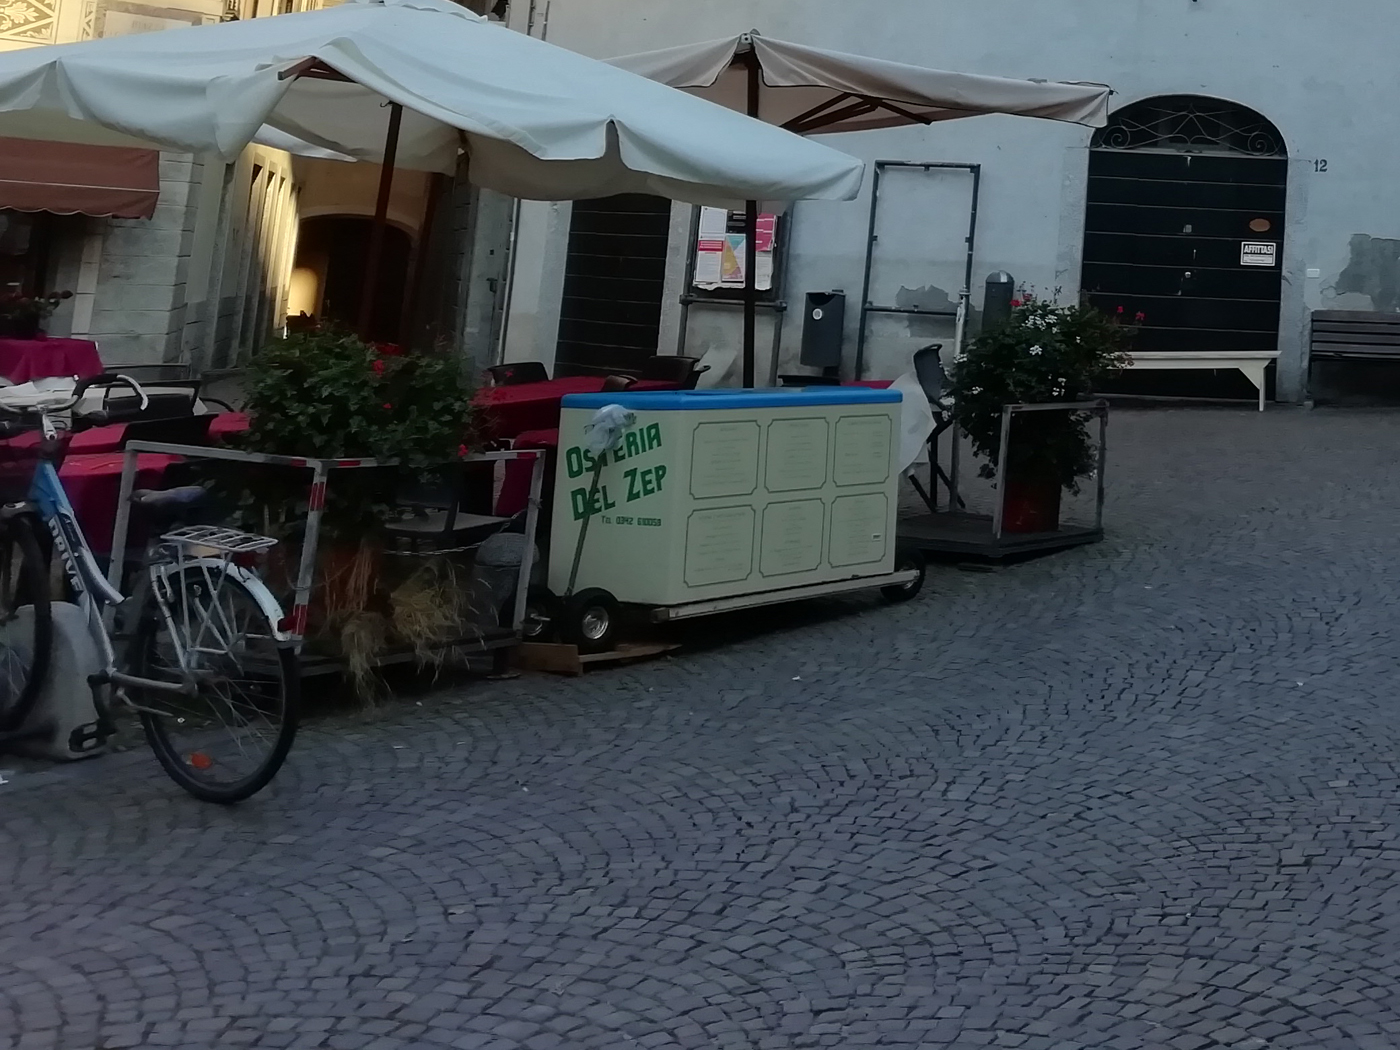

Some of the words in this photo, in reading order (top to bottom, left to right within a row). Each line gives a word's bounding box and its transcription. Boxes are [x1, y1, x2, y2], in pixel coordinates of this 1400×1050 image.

[1313, 158, 1328, 173] 12
[1243, 244, 1274, 254] AFFITTASI
[570, 485, 616, 521] DEL
[623, 464, 667, 503] ZEP
